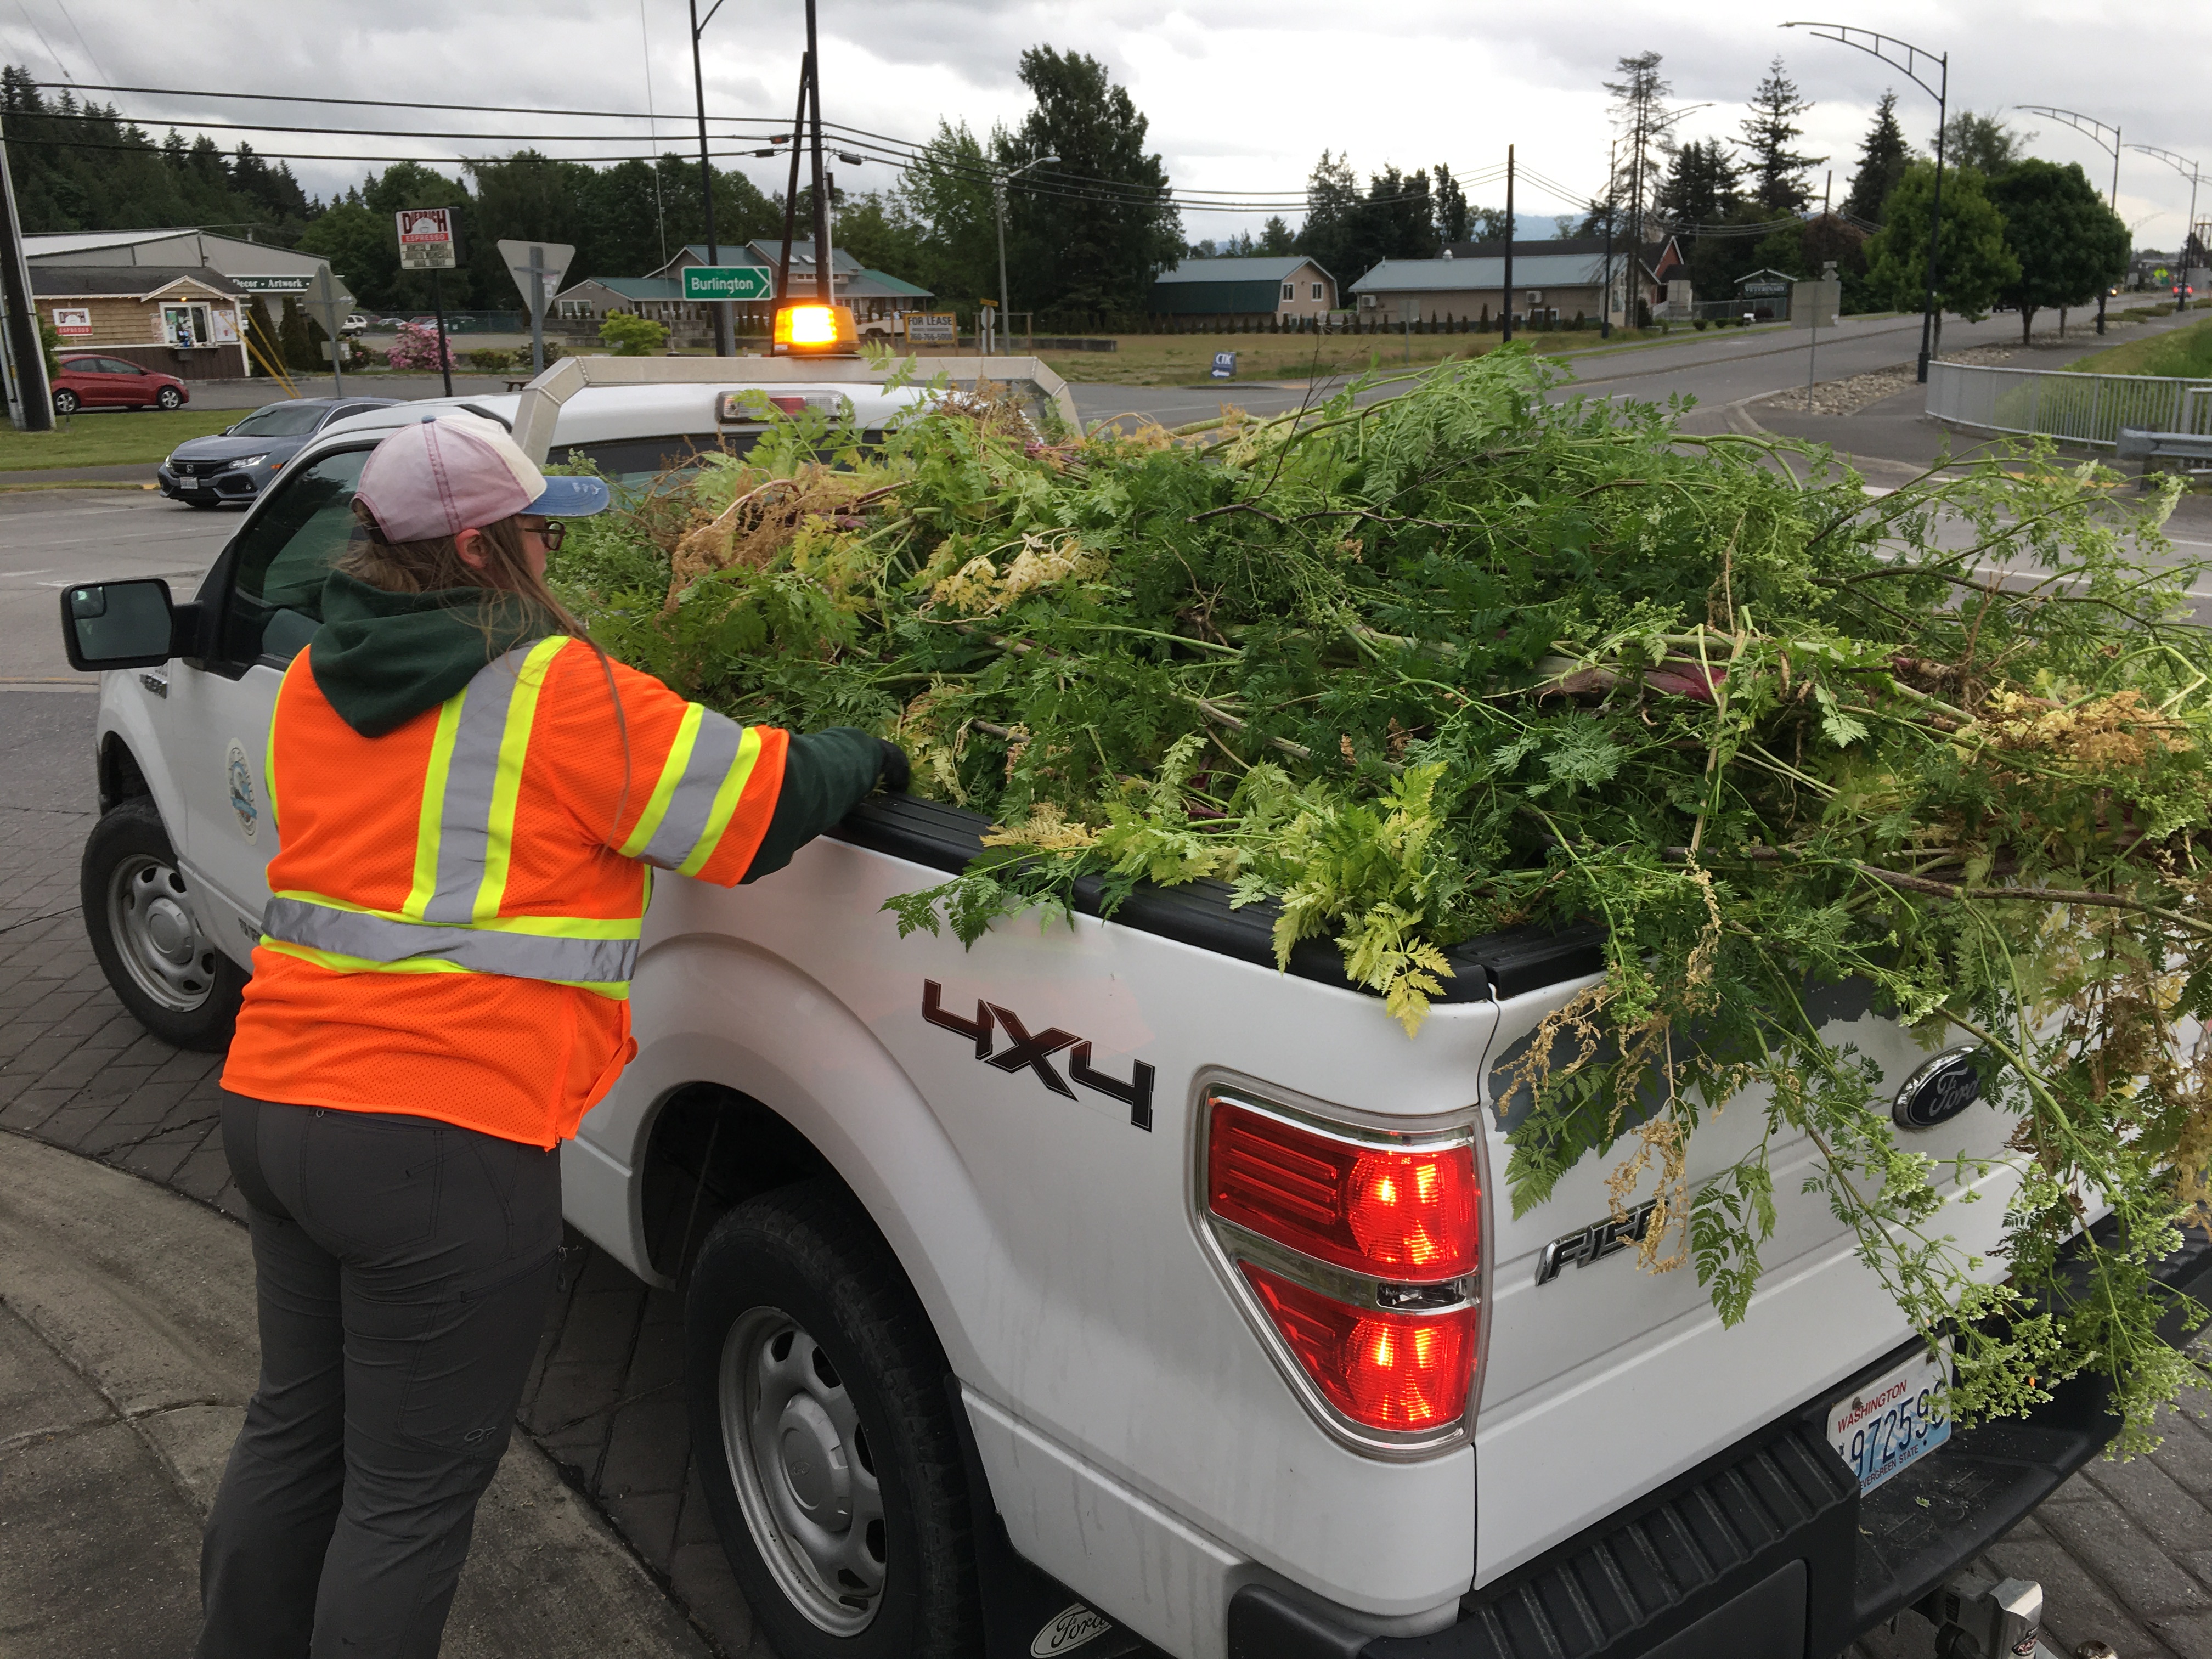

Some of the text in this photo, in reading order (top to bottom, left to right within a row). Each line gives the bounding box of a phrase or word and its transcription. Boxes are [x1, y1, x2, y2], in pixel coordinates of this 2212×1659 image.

[268, 279, 303, 287] Artwork
[691, 277, 754, 294] Burlington
[907, 317, 952, 325] FOR LEASE
[1216, 353, 1232, 364] CTK
[1838, 1379, 1908, 1433] WASHINGTON
[1899, 1444, 1919, 1463] STATE
